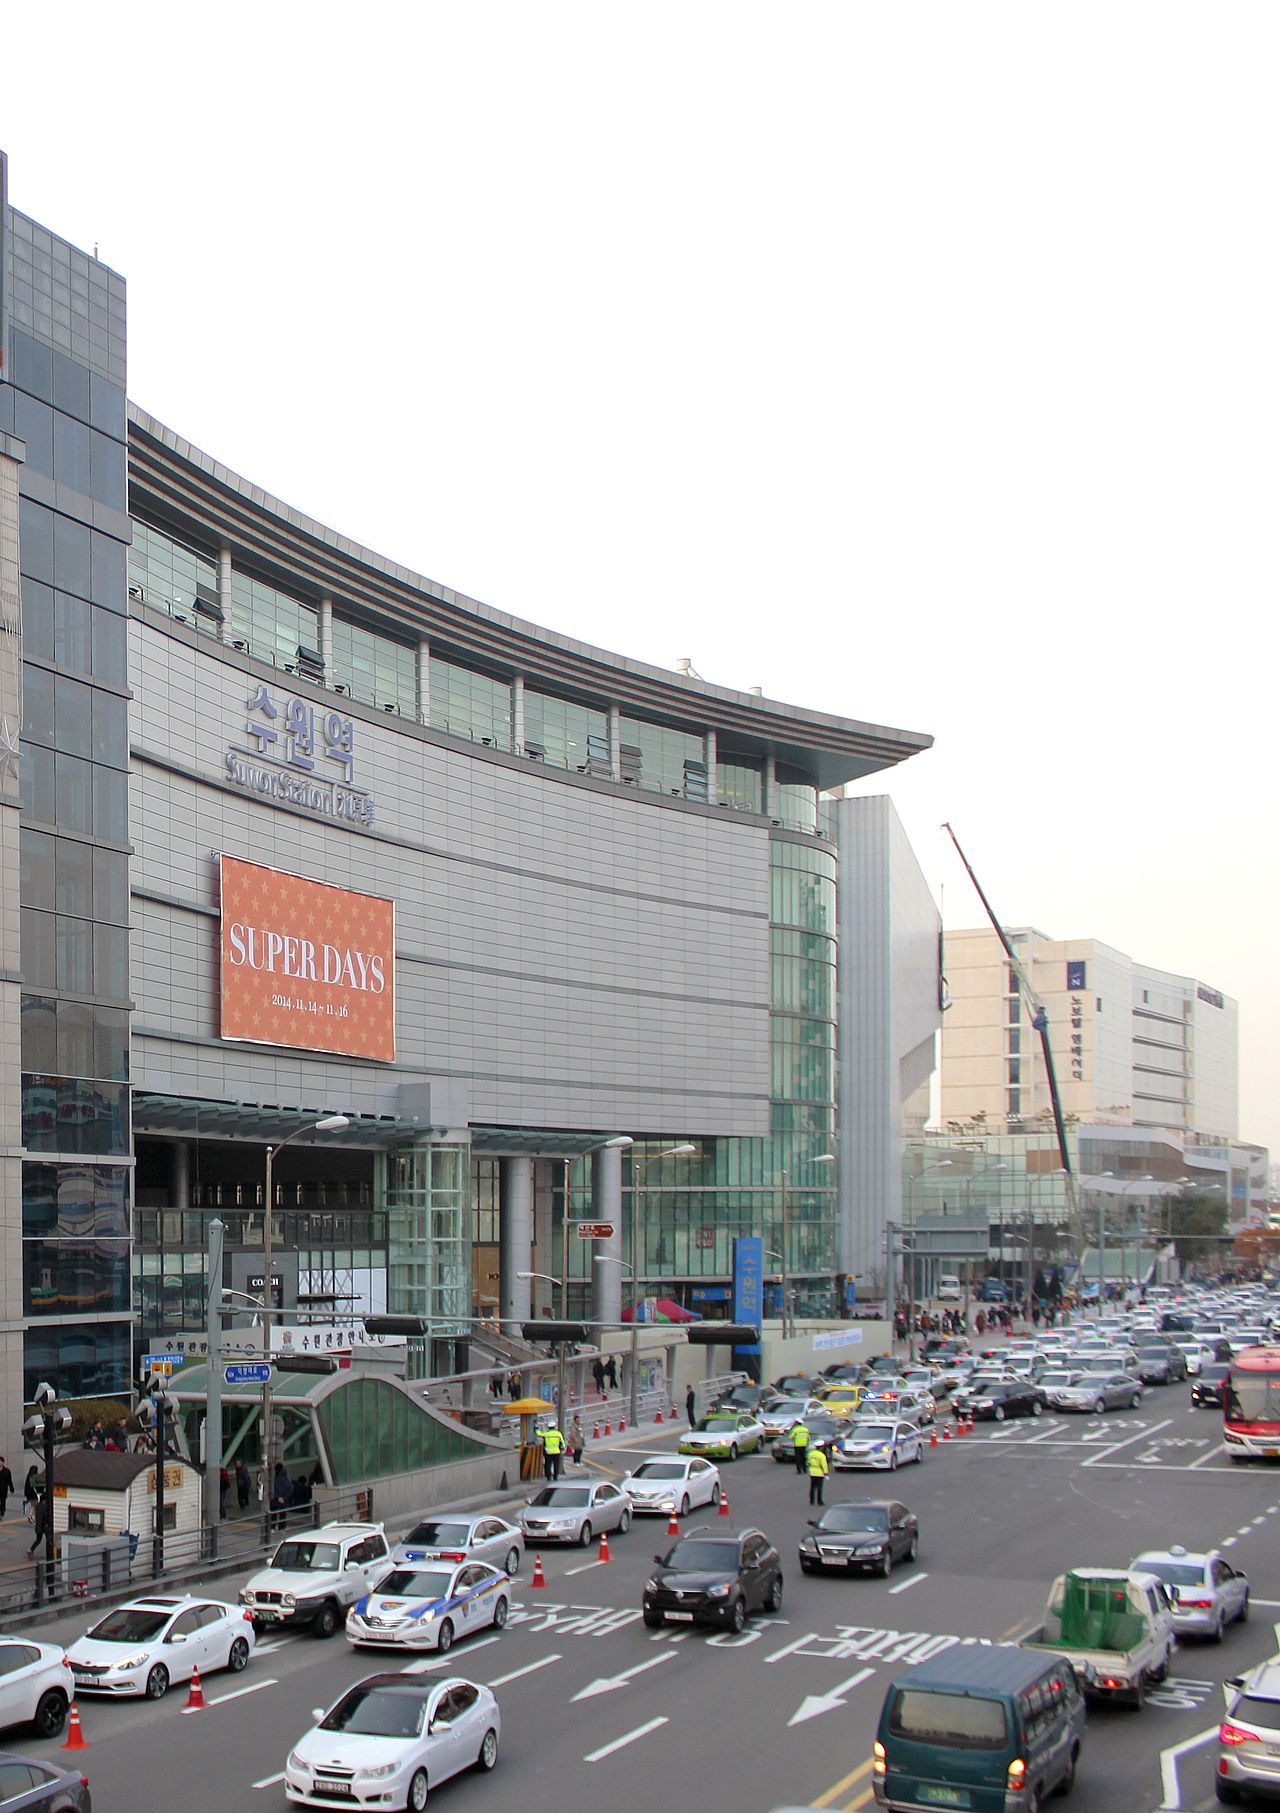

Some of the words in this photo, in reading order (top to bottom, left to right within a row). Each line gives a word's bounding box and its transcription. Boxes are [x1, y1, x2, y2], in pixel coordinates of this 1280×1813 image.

[247, 684, 354, 783] 수원역
[225, 752, 278, 798] Suwon
[278, 771, 331, 814] Station
[229, 922, 318, 983] SUPER
[322, 944, 386, 995] DAYS
